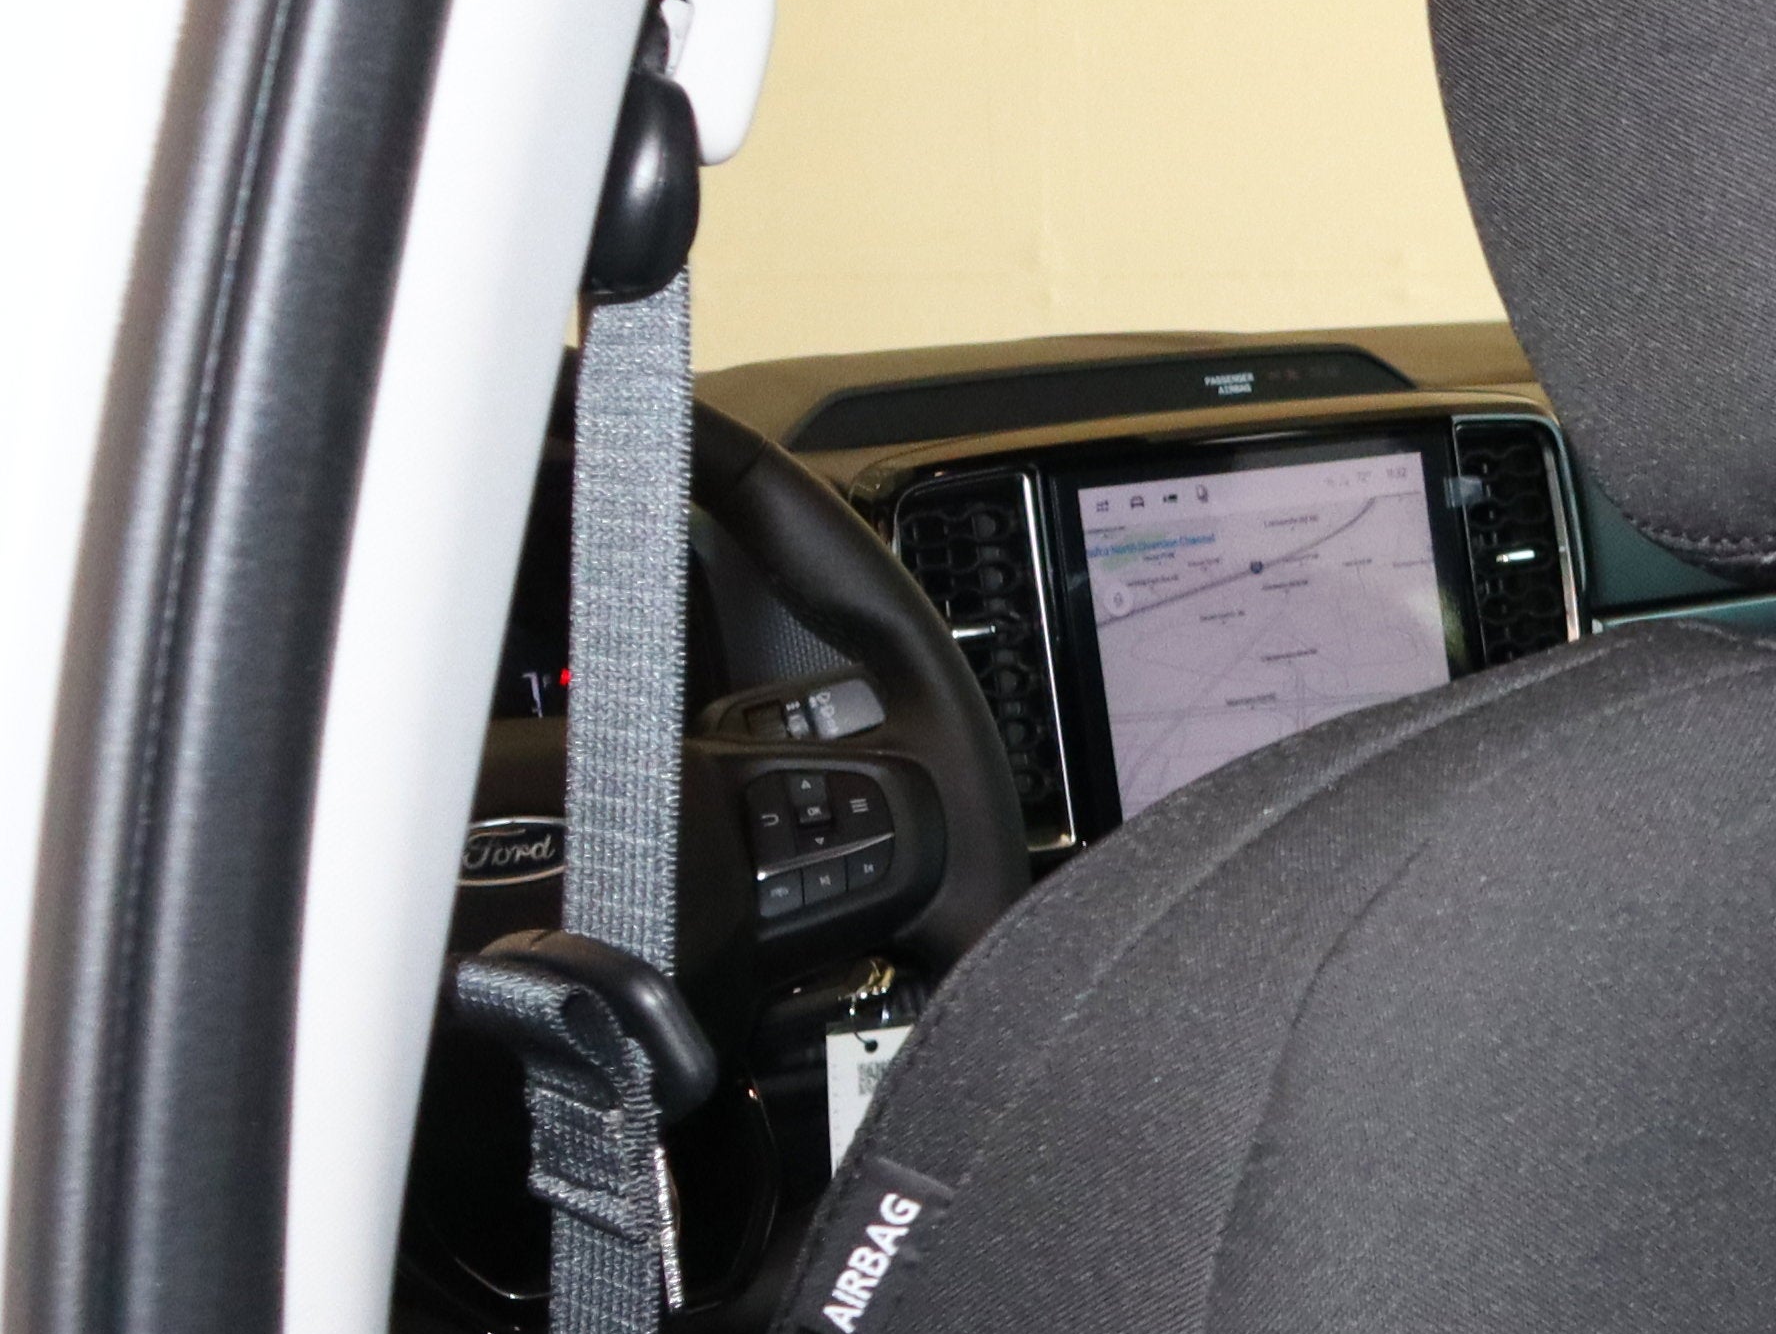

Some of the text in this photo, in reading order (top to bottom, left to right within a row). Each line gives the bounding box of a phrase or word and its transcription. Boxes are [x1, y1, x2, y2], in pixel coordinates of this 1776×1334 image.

[1203, 371, 1255, 386] PASSENGER
[461, 827, 557, 870] Ford
[822, 1192, 923, 1334] AIRBAG
